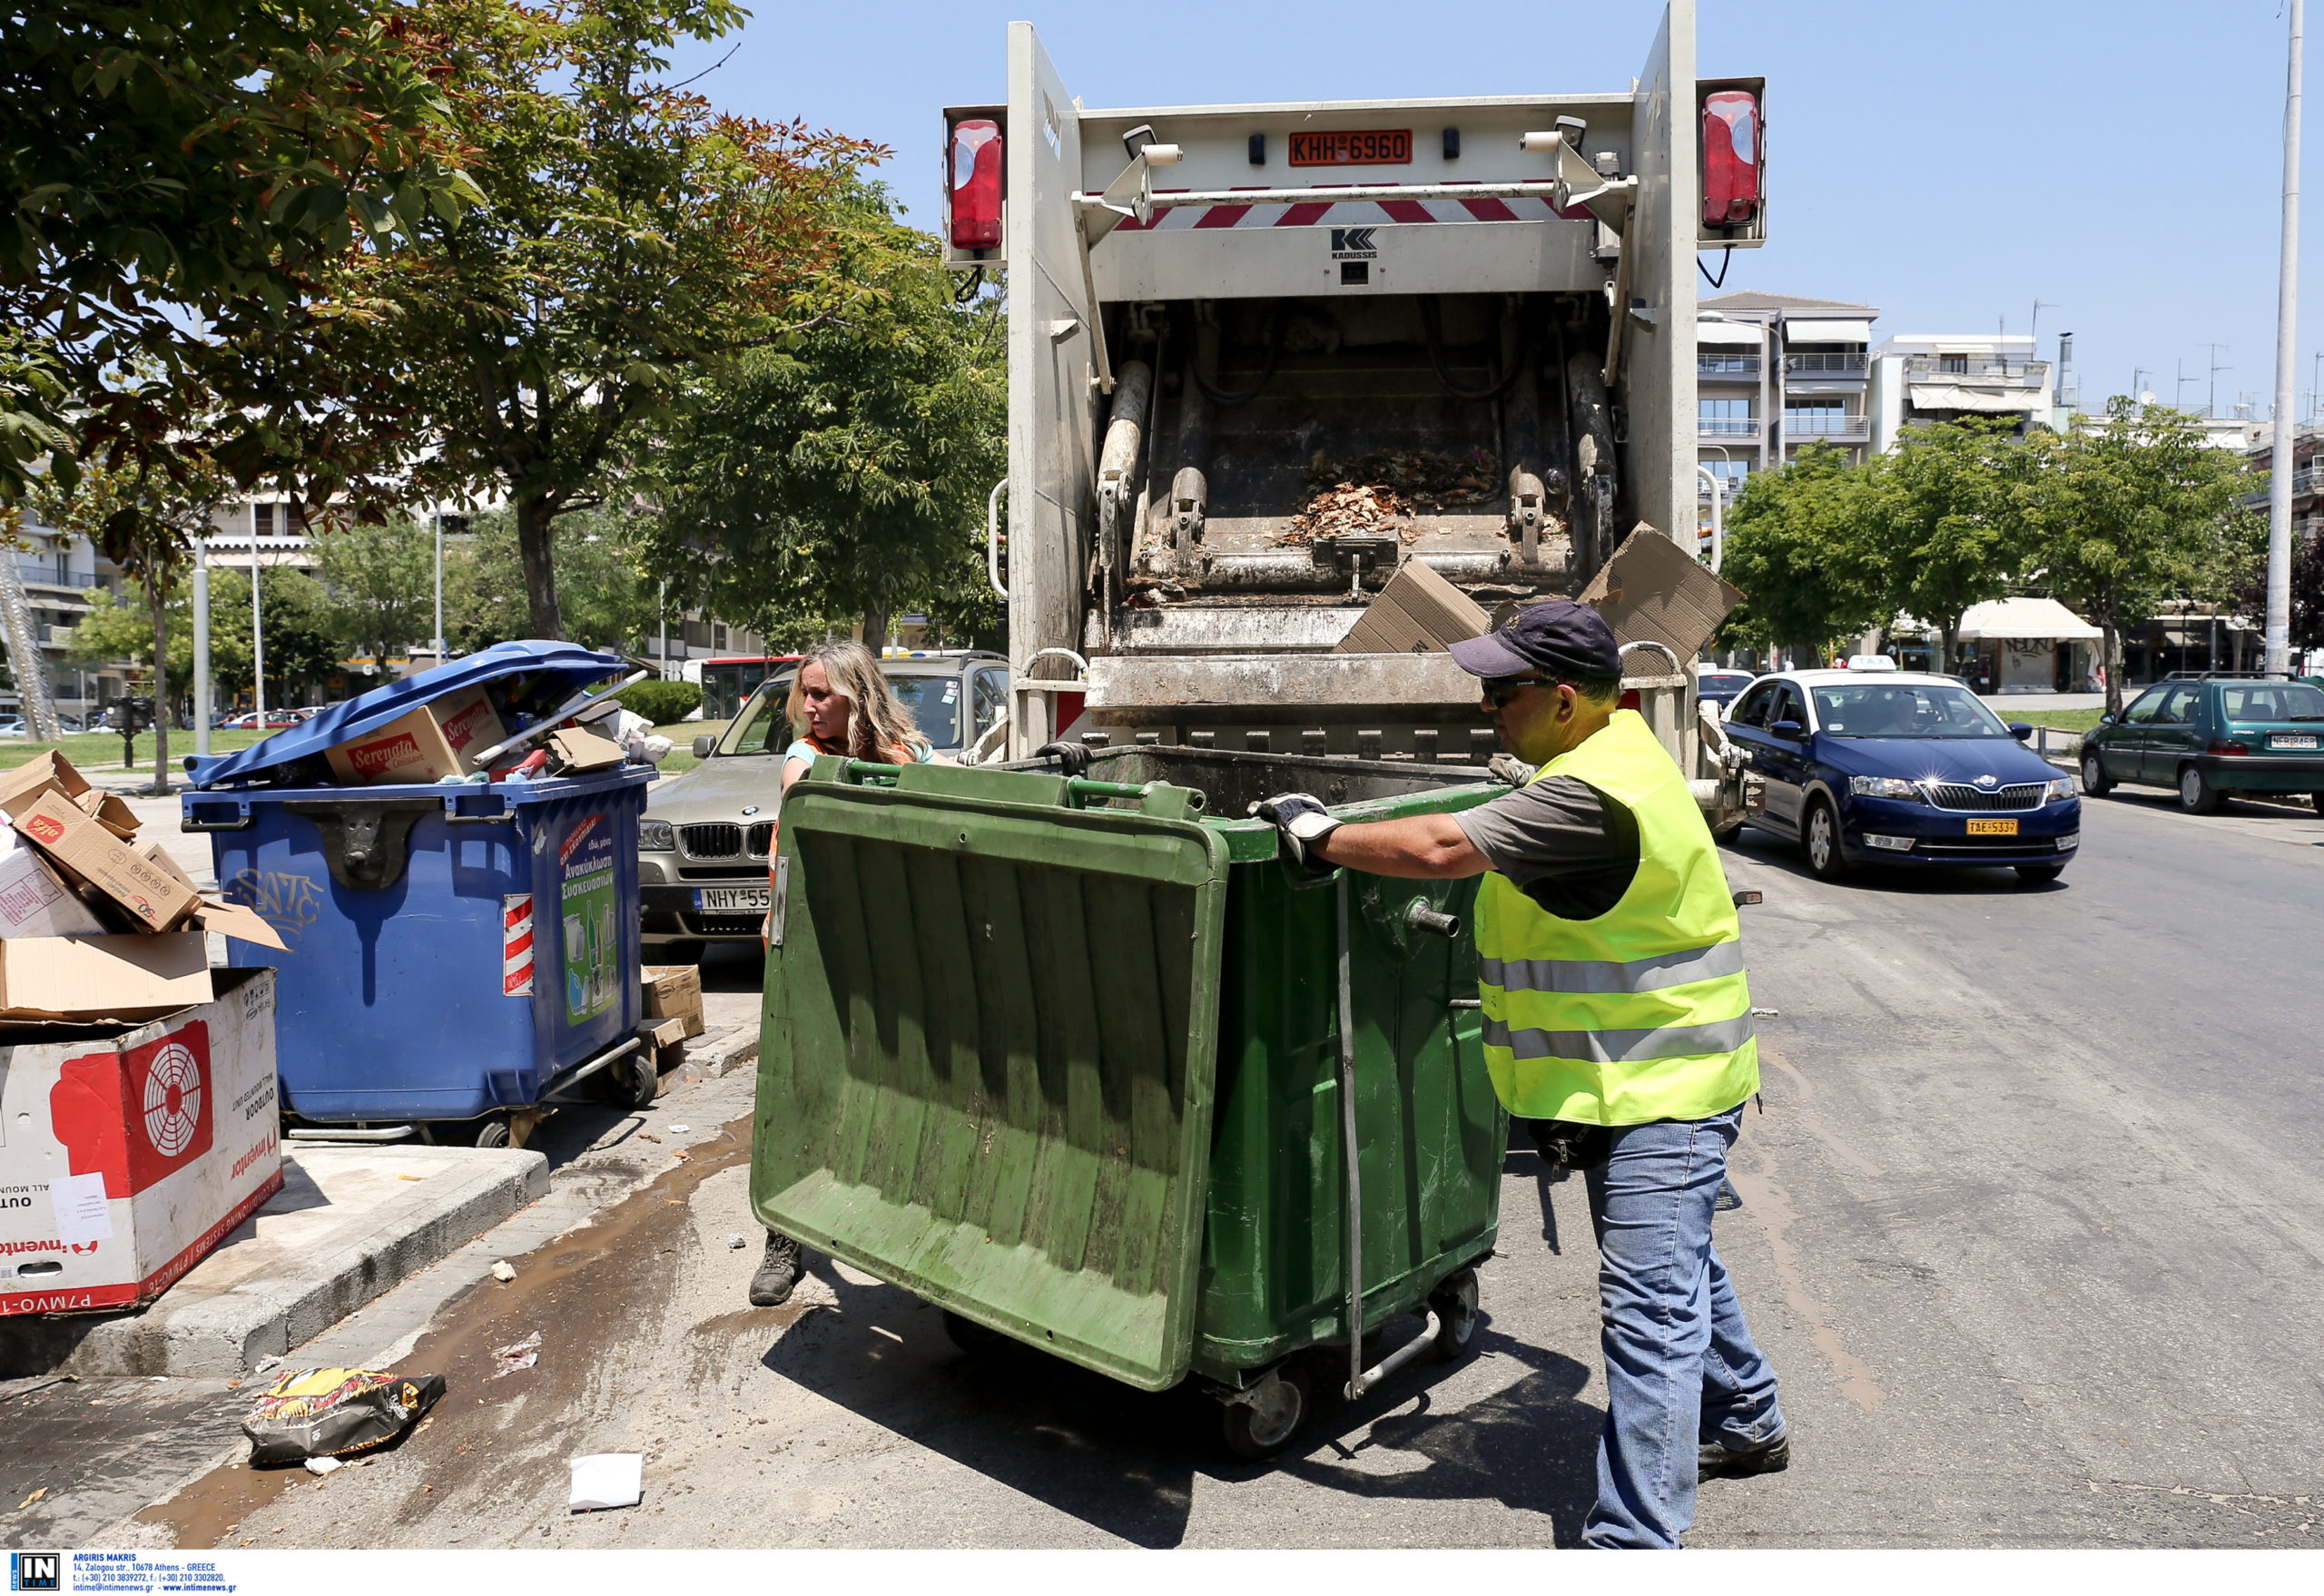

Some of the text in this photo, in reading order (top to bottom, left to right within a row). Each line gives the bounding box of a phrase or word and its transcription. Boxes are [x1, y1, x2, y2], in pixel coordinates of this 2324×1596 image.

[1856, 657, 1891, 665] TAXI
[448, 706, 486, 741] Serenata
[355, 740, 413, 768] Serenata
[33, 819, 59, 837] alfa
[566, 855, 613, 881] Ανακύκλωση
[562, 871, 614, 901] Συσκευασιών
[245, 1088, 274, 1121] OUTDOOR
[230, 1138, 267, 1180] inventor
[195, 1224, 225, 1257] SYSTEMS
